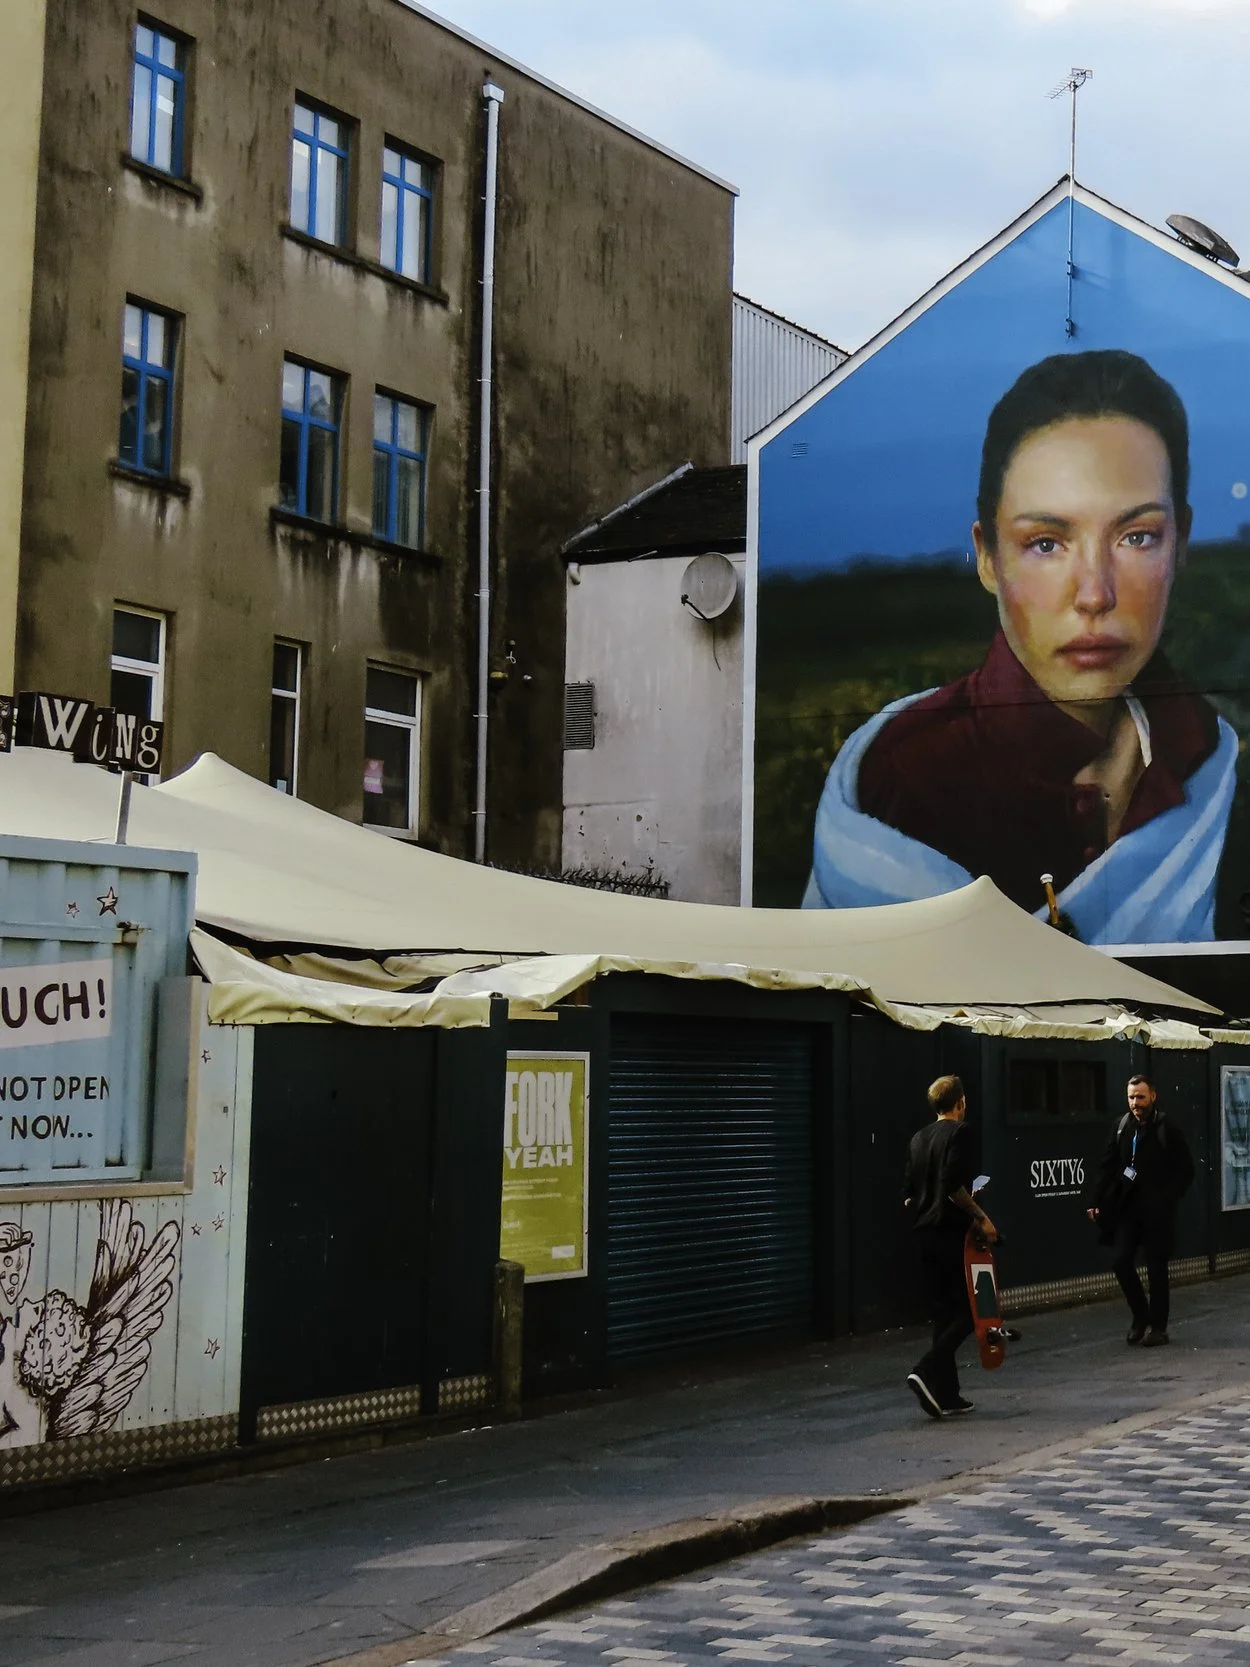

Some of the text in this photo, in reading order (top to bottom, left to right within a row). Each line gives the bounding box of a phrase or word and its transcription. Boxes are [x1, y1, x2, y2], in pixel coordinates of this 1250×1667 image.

[1, 978, 106, 1029] UCH!
[504, 1071, 573, 1147] FORK
[504, 1145, 573, 1169] YEAH
[1030, 1158, 1085, 1188] SIXTY6
